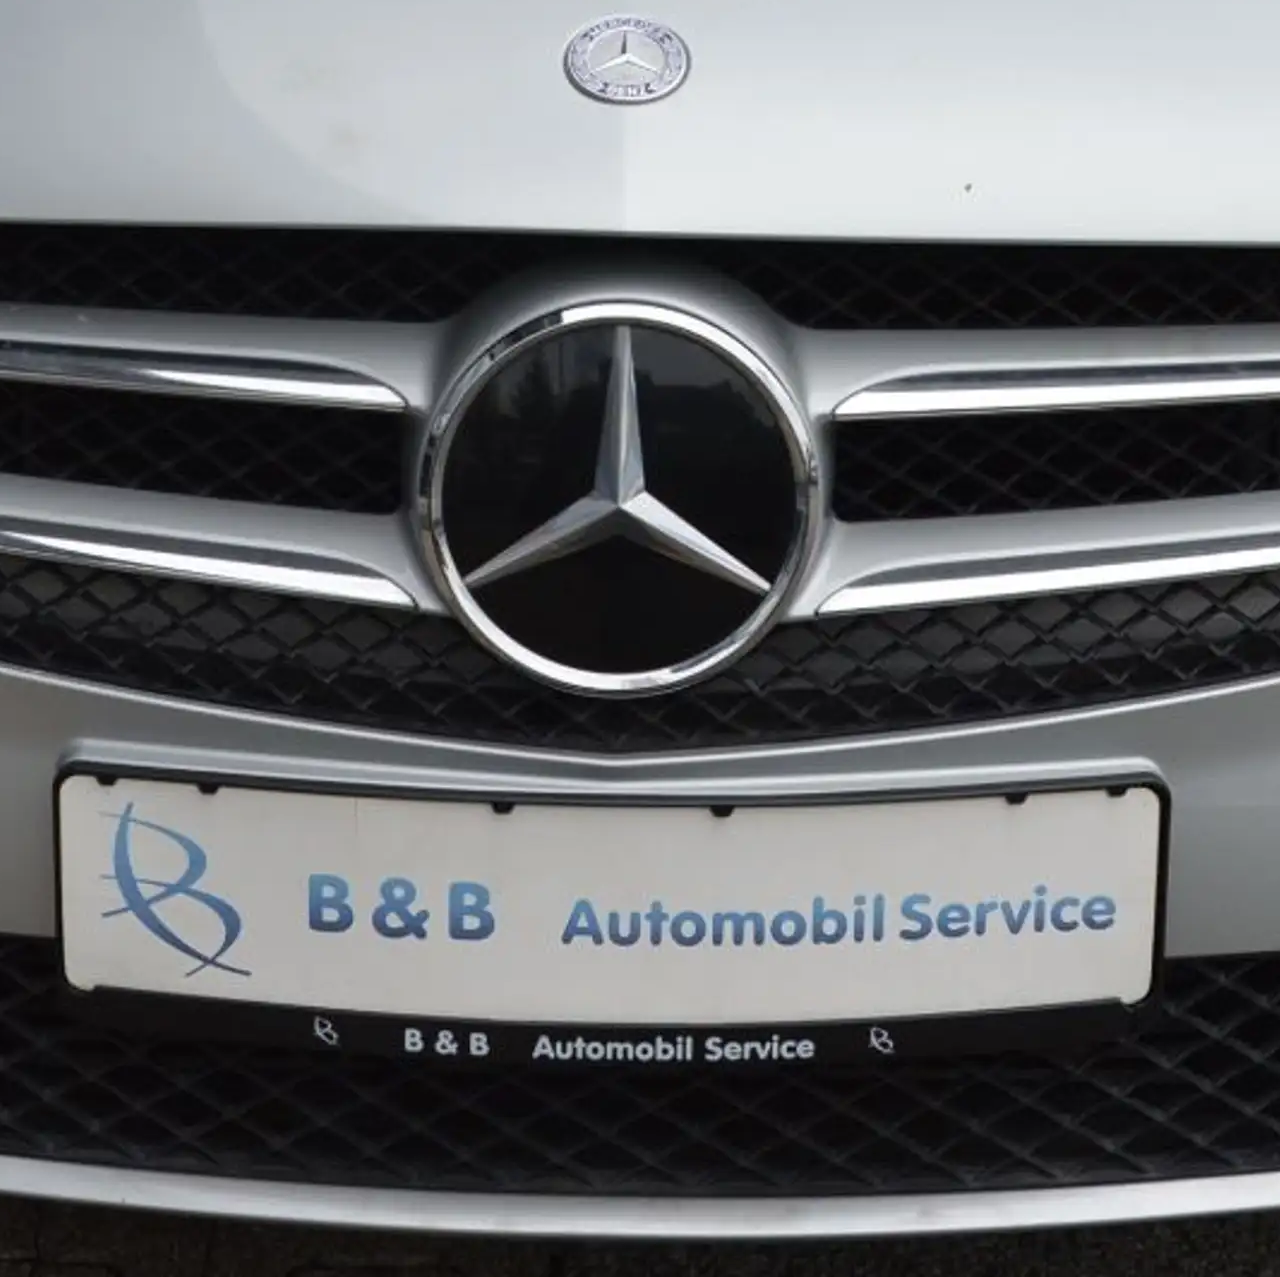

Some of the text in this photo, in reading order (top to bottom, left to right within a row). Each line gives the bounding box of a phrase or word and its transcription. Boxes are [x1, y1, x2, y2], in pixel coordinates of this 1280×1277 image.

[308, 873, 1117, 947] B & B Automobil Service
[404, 1027, 816, 1062] B & B Automobil Service
